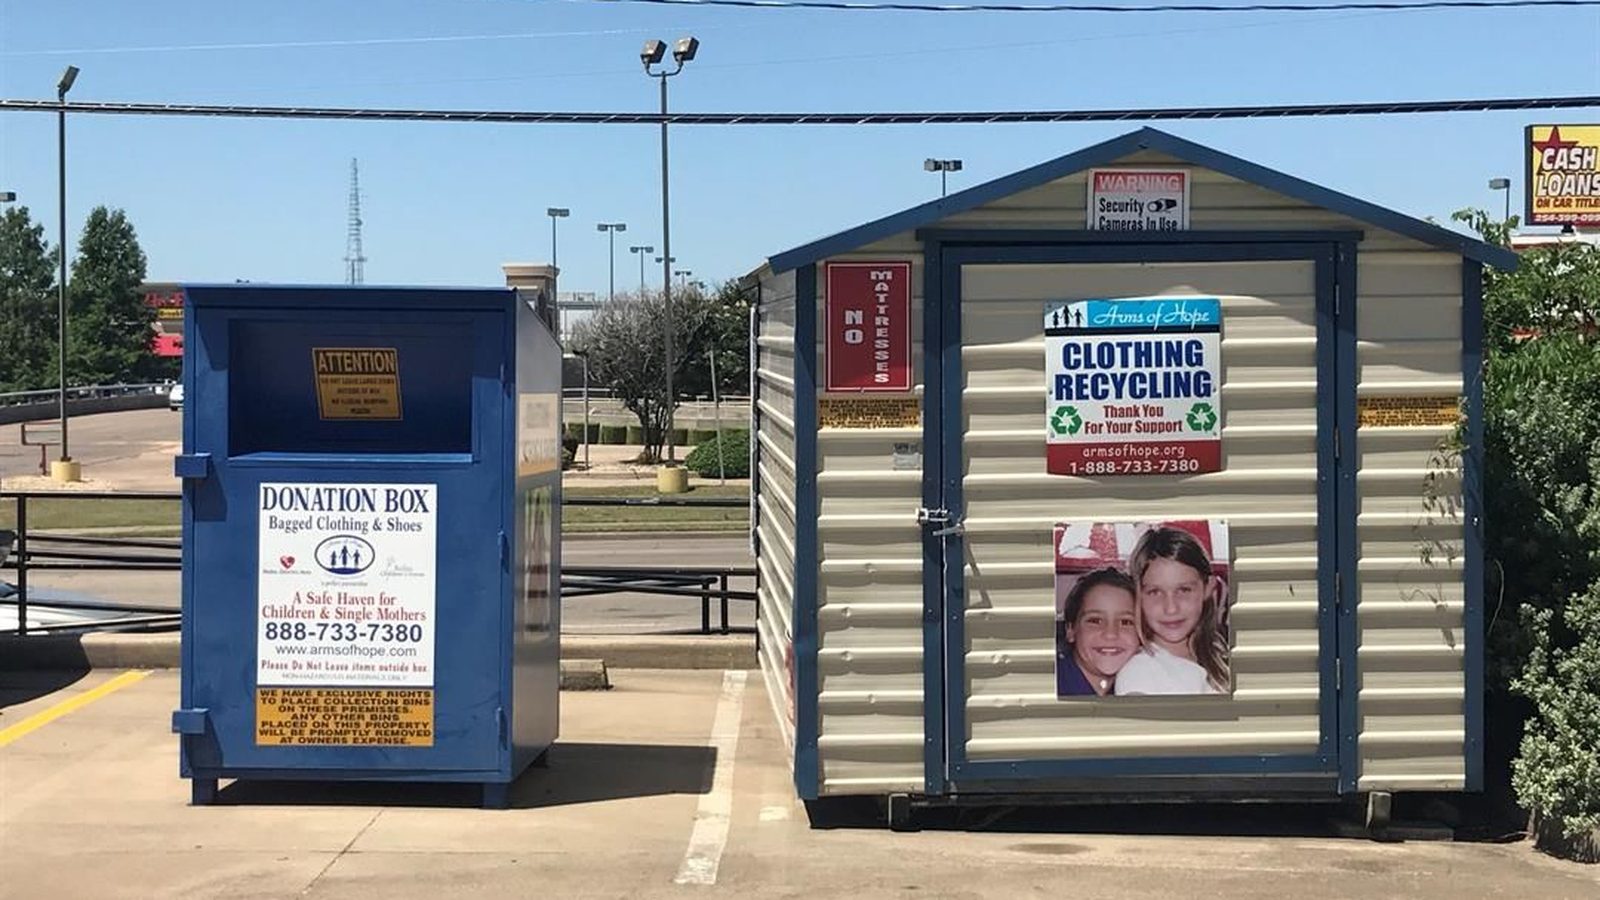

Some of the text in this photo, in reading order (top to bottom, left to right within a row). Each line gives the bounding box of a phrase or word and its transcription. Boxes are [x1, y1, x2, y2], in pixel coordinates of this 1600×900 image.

[1541, 146, 1597, 171] CASH
[1099, 175, 1180, 192] WARNING
[1536, 173, 1600, 197] LOANS
[1099, 197, 1144, 217] Security
[1536, 198, 1550, 208] ON
[1553, 198, 1572, 208] CAR
[1099, 216, 1177, 231] Cameras In Use
[1093, 302, 1209, 331] Arms of Hope
[845, 310, 863, 344] NO
[870, 271, 892, 383] MATTRESSES
[319, 352, 395, 373] ATTENTION
[1062, 340, 1204, 370] CLOTHING
[1055, 371, 1212, 401] RECYCLING
[1104, 404, 1164, 419] Thank You
[1084, 420, 1183, 436] For Your Support
[1082, 445, 1186, 459] armsofhope.org
[1070, 459, 1200, 475] 1-888-733-7380
[262, 486, 430, 514] DONATION BOX
[268, 515, 423, 535] Bagged Clothing & Shoes
[293, 591, 397, 606] A Safe Haven for
[262, 605, 427, 623] Children & Single Mothers
[265, 622, 423, 643] 888-733-7380
[275, 645, 417, 658] www.armsofhope.com
[261, 660, 427, 673] Please Do Not Leave items outside box
[317, 690, 382, 698] EXCLUSIVE
[403, 698, 430, 706] BINS
[259, 729, 285, 737] WILL
[291, 729, 305, 737] BE
[310, 729, 371, 737] PROMPTLY
[261, 721, 308, 729] PLACED
[312, 721, 329, 729] ON
